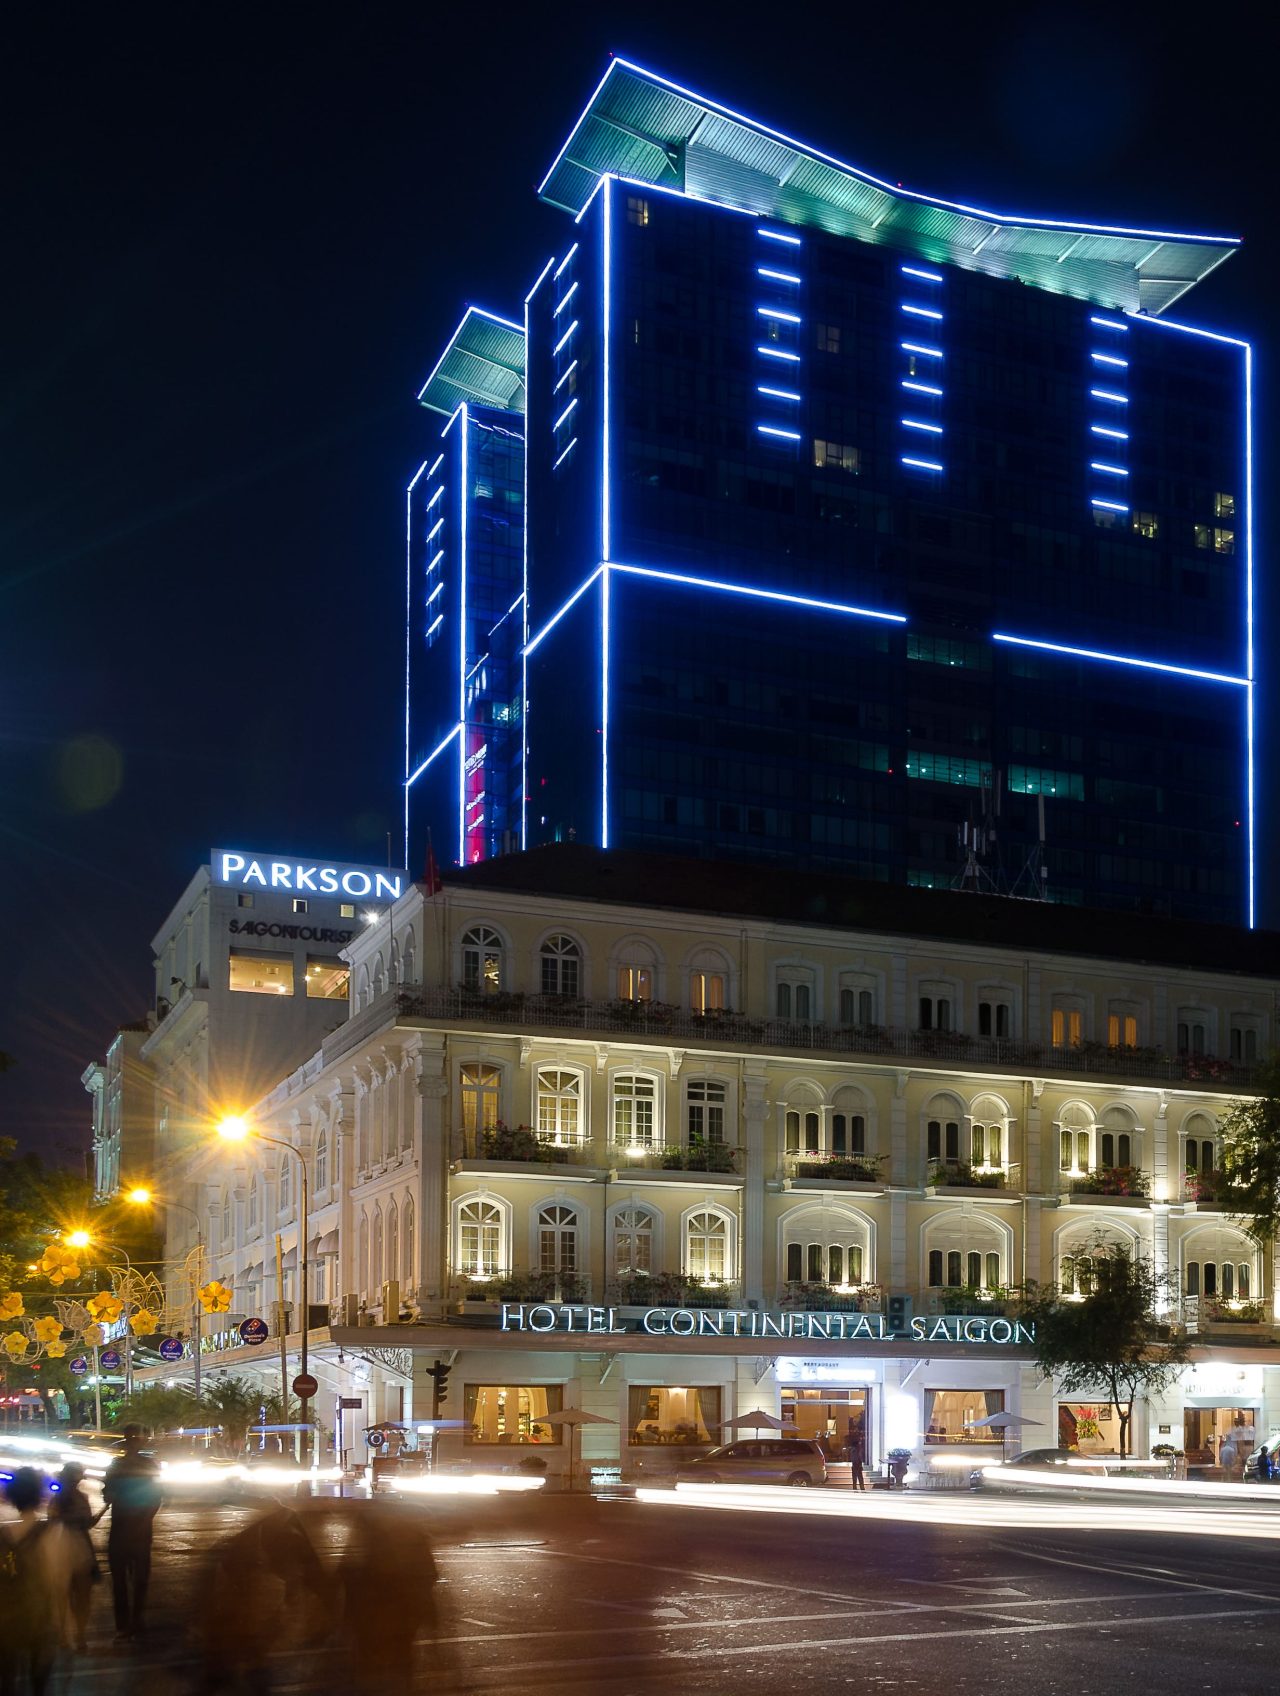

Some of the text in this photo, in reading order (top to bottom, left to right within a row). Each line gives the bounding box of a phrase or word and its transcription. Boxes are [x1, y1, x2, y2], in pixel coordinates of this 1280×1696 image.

[222, 854, 401, 898] PARKSON
[229, 919, 353, 943] SAIGONTOURIST
[501, 1304, 1036, 1344] HOTEL CONTINENTAL SAIGON
